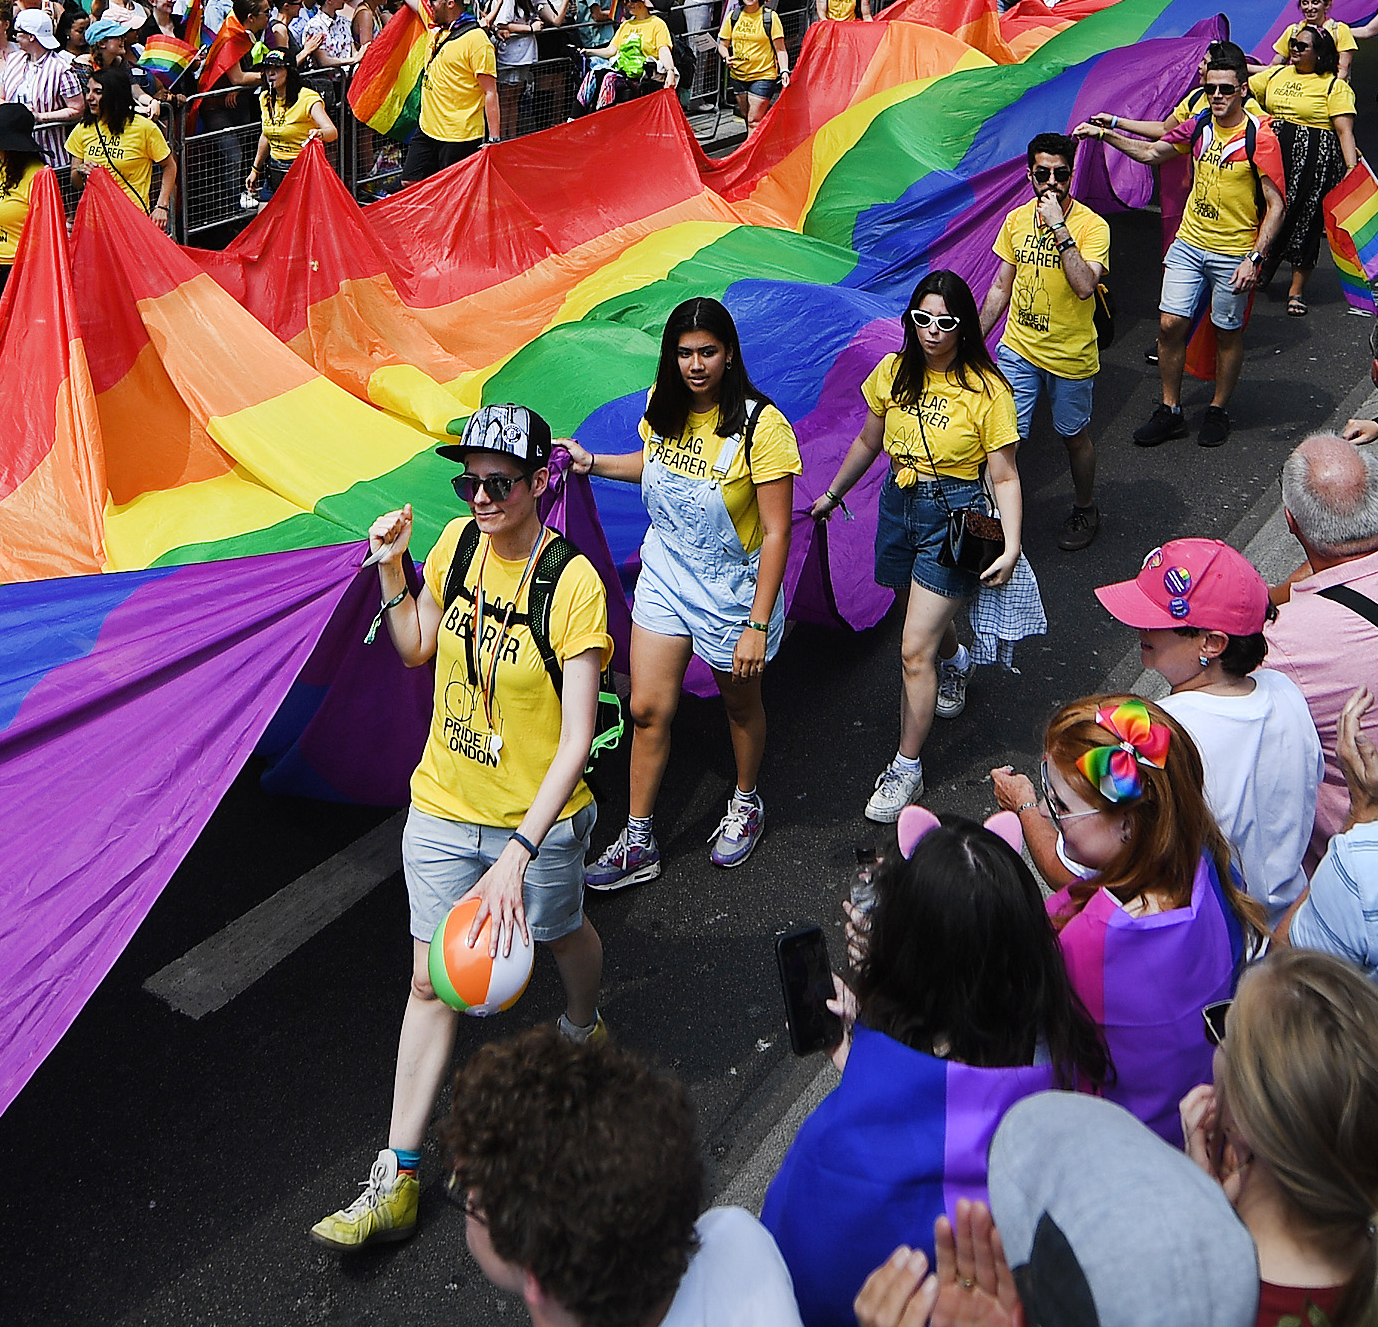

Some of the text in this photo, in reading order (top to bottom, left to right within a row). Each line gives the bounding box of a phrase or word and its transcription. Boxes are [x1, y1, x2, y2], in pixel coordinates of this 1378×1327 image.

[1273, 88, 1304, 97] BEARER
[1282, 81, 1303, 91] FLAG
[1199, 153, 1234, 171] EARR
[1024, 234, 1056, 252] FLAG
[1014, 249, 1061, 269] BEARER
[668, 435, 704, 455] FLAG
[443, 717, 483, 751] PRIDE
[447, 737, 498, 768] ONDON
